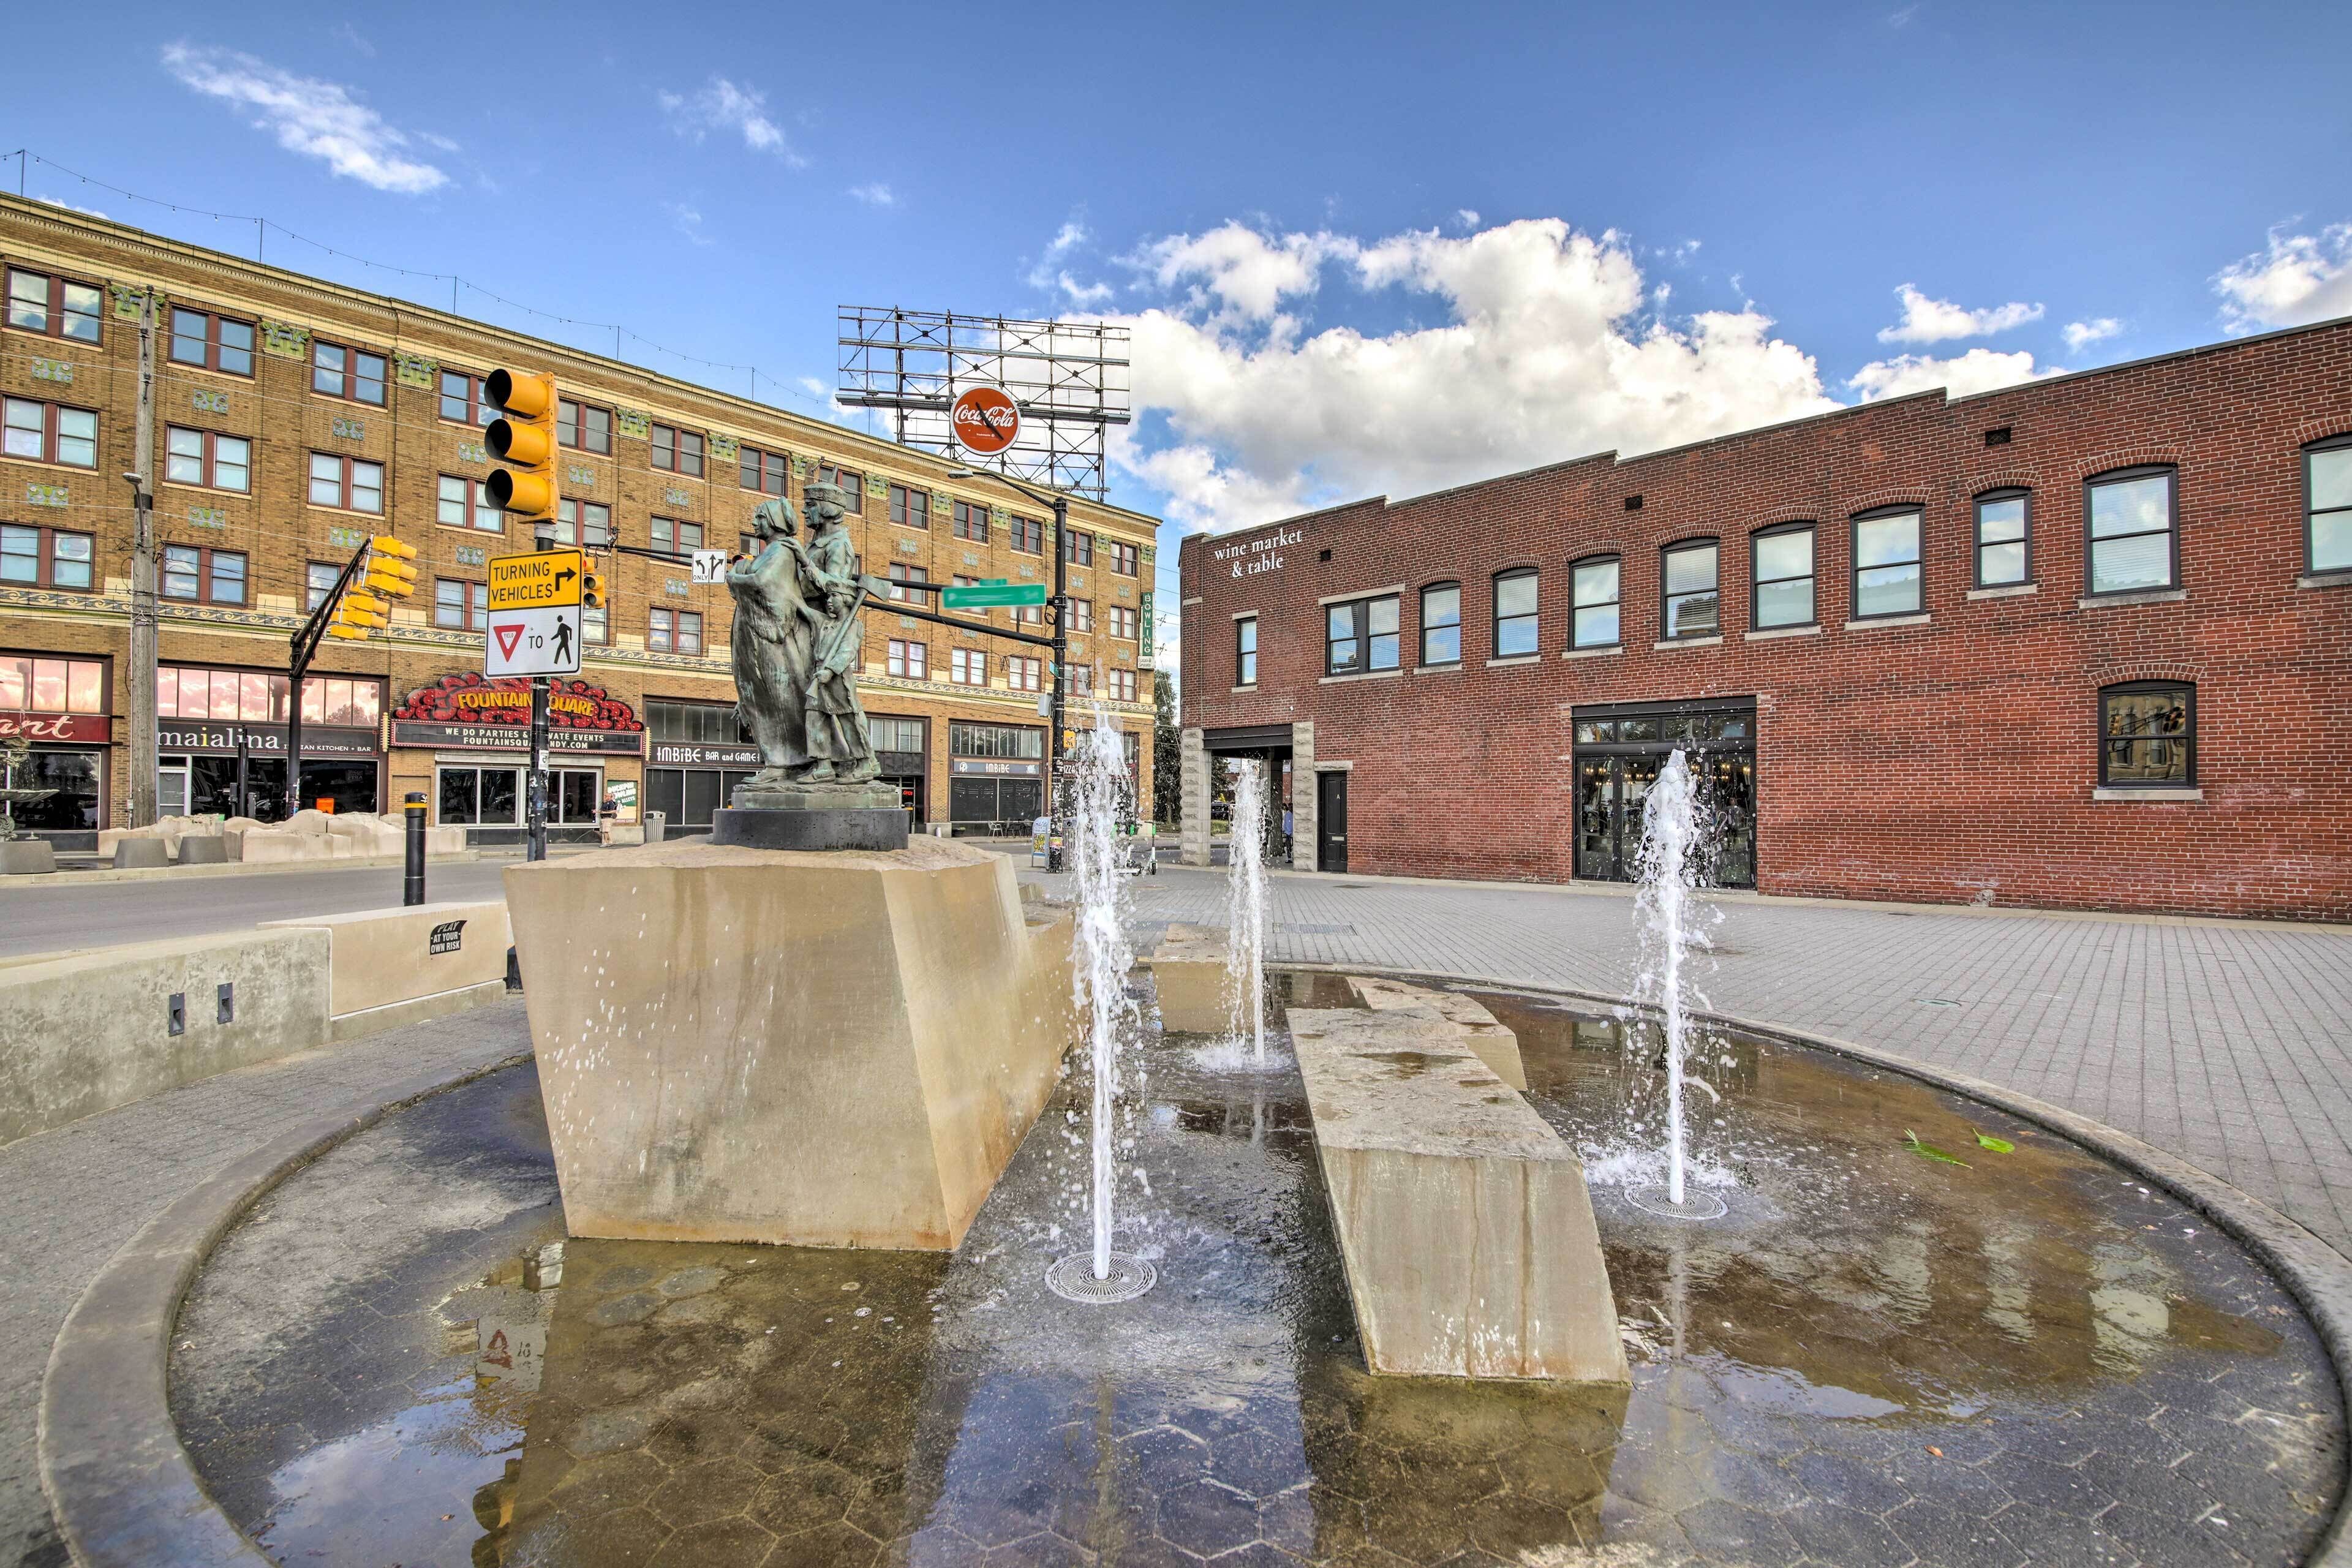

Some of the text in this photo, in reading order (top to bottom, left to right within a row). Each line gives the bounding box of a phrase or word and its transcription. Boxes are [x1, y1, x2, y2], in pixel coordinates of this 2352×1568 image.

[1214, 527, 1302, 560] wine market
[494, 562, 550, 581] TURNING
[1232, 551, 1284, 578] & table
[492, 583, 552, 602] VEHICLES
[529, 635, 543, 649] TO
[458, 692, 595, 716] FOUNTAIN QUARE
[158, 727, 280, 749] maialina
[480, 729, 519, 738] PARTIES
[705, 751, 720, 761] BAR
[722, 753, 734, 761] and
[735, 752, 756, 761] GAME
[1063, 765, 1076, 774] IZZA
[437, 921, 460, 933] PLAY
[433, 932, 458, 943] AT YOUR
[431, 940, 460, 954] OWN RISK
